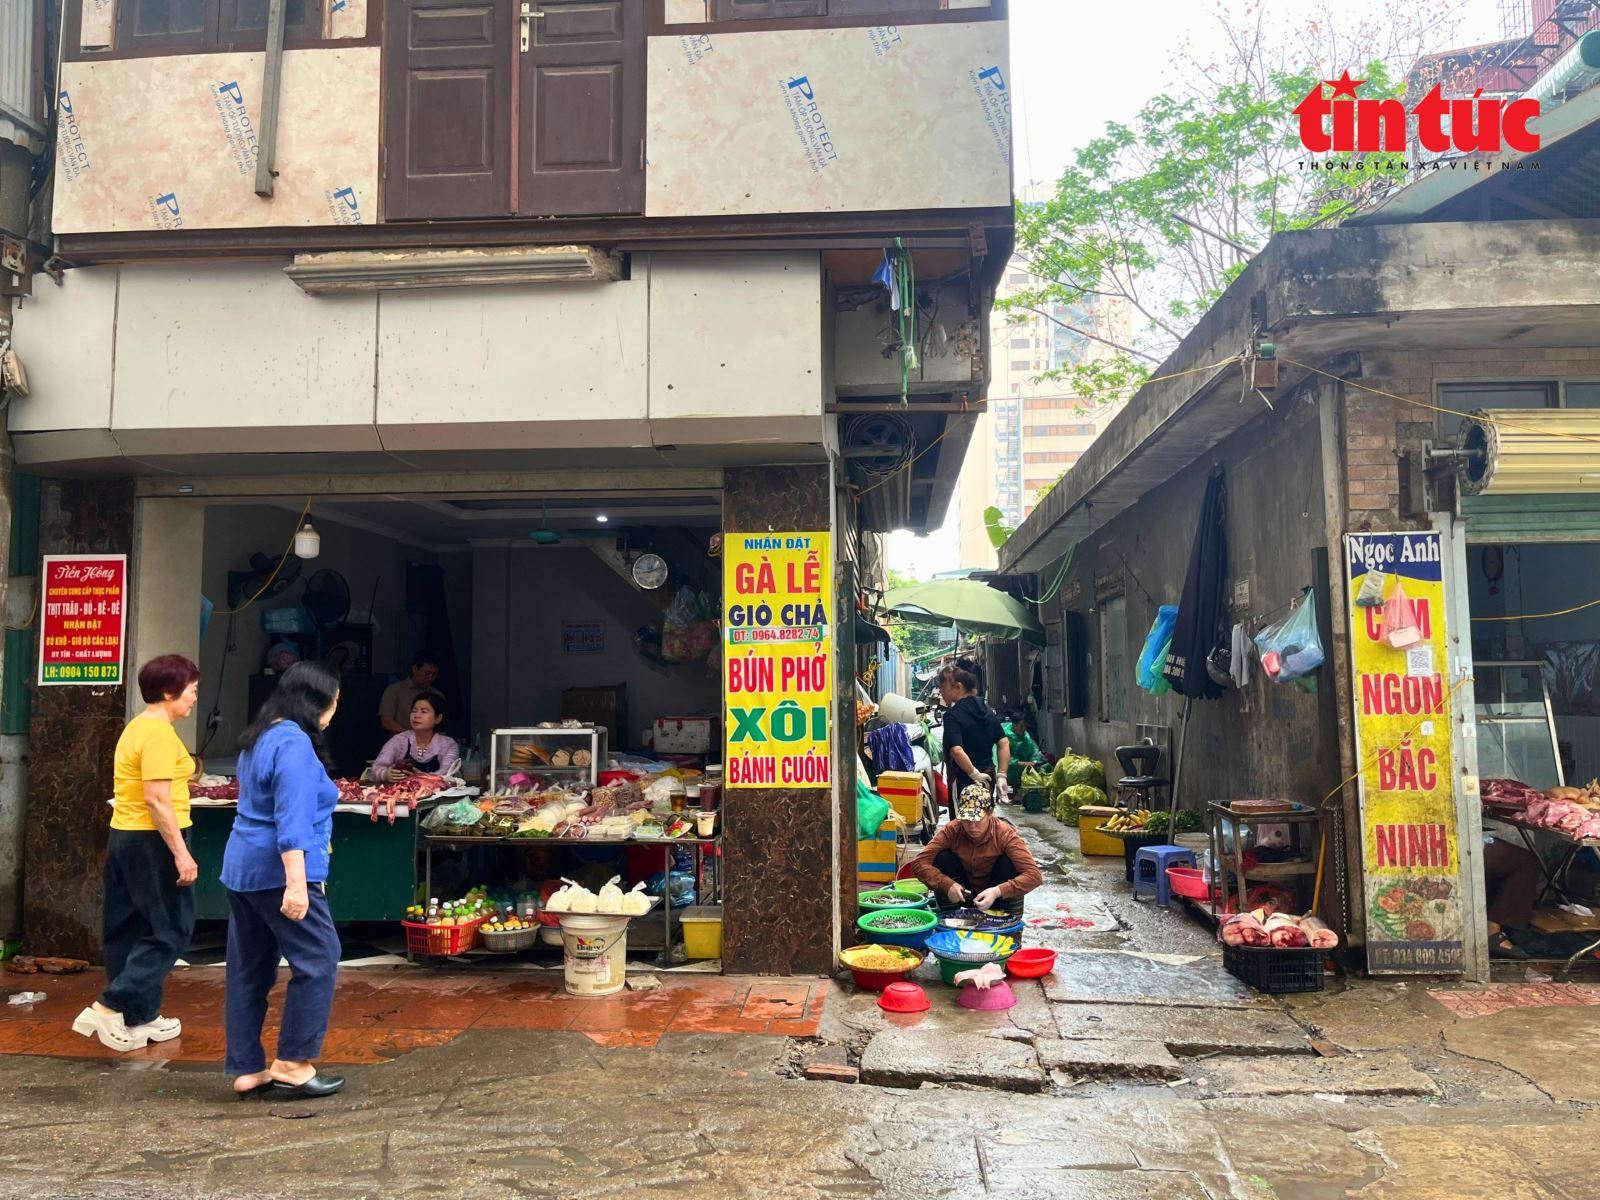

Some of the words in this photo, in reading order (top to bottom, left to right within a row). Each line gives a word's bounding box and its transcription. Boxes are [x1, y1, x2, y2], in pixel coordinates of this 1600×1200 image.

[787, 75, 838, 162] PROTECT
[744, 537, 782, 551] NHẬN
[785, 537, 811, 551] ĐẶT
[1351, 537, 1394, 570] Ngọc
[1400, 535, 1439, 563] Anh
[735, 556, 776, 594] GÀ
[787, 550, 820, 593] LỄ
[48, 602, 61, 618] THỊT
[63, 600, 79, 615] TRÂU
[64, 619, 85, 630] NHẬN
[728, 600, 772, 626] GIÒ
[781, 598, 827, 626] CHẢ
[1365, 599, 1430, 641] CM
[45, 666, 58, 678] LH:
[60, 666, 81, 677] 0904
[83, 666, 99, 677] 150
[101, 665, 117, 677] 873
[729, 650, 773, 693] BÚN
[781, 642, 827, 692] PHỞ
[1362, 673, 1444, 715] NGON
[729, 700, 827, 742] XÔI
[729, 751, 776, 783] BÁNH
[781, 746, 828, 783] CUỐN
[1378, 731, 1437, 791] BẮC
[1376, 824, 1449, 867] NINH
